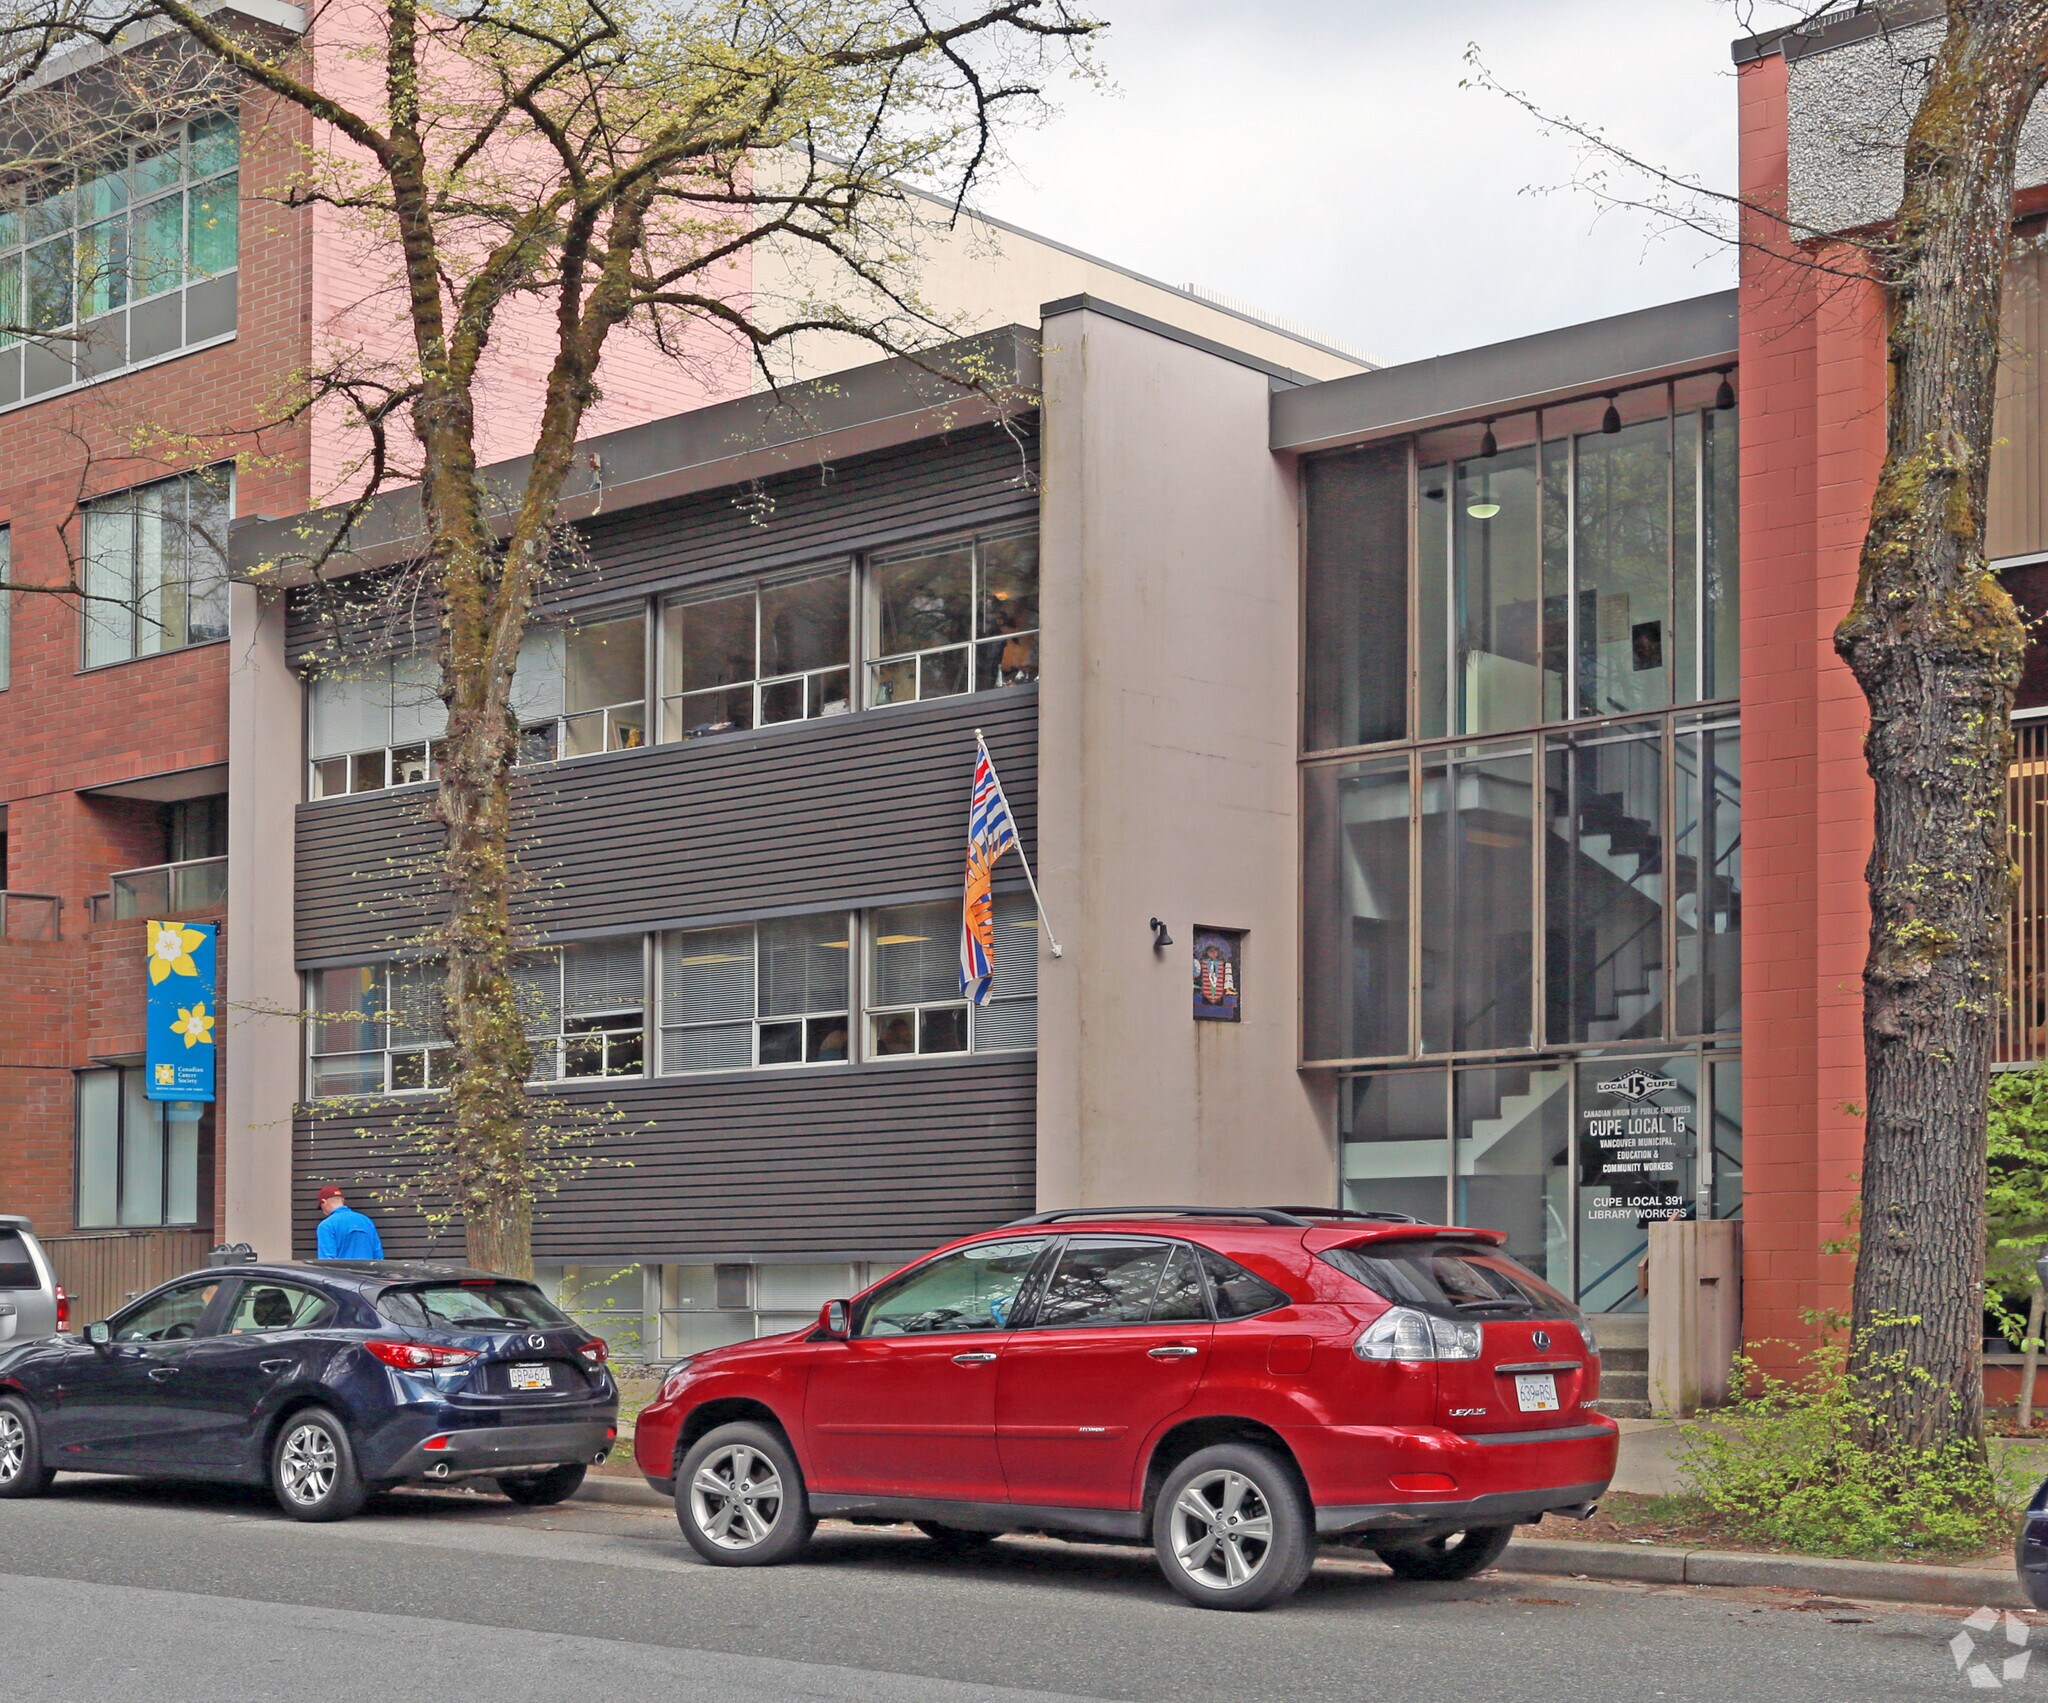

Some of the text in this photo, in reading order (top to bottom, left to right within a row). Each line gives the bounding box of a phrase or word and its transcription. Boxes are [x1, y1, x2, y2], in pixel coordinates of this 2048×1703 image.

[1628, 1077, 1646, 1096] 15
[1646, 1080, 1676, 1088] CUPE
[1584, 1105, 1692, 1118] CANADIAN UNION OF PUBLIC EMPLOYEES
[1590, 1116, 1685, 1136] CUPE LOCAL 15
[1599, 1138, 1636, 1148] VANCOUVER
[1617, 1149, 1659, 1160] EDUCATION &
[1602, 1161, 1674, 1173] COMMUNITY WORKERS
[1593, 1196, 1683, 1207] CUPE LOCAL 391
[1588, 1209, 1631, 1219] LIBRARY
[1449, 1407, 1487, 1416] LEXUS
